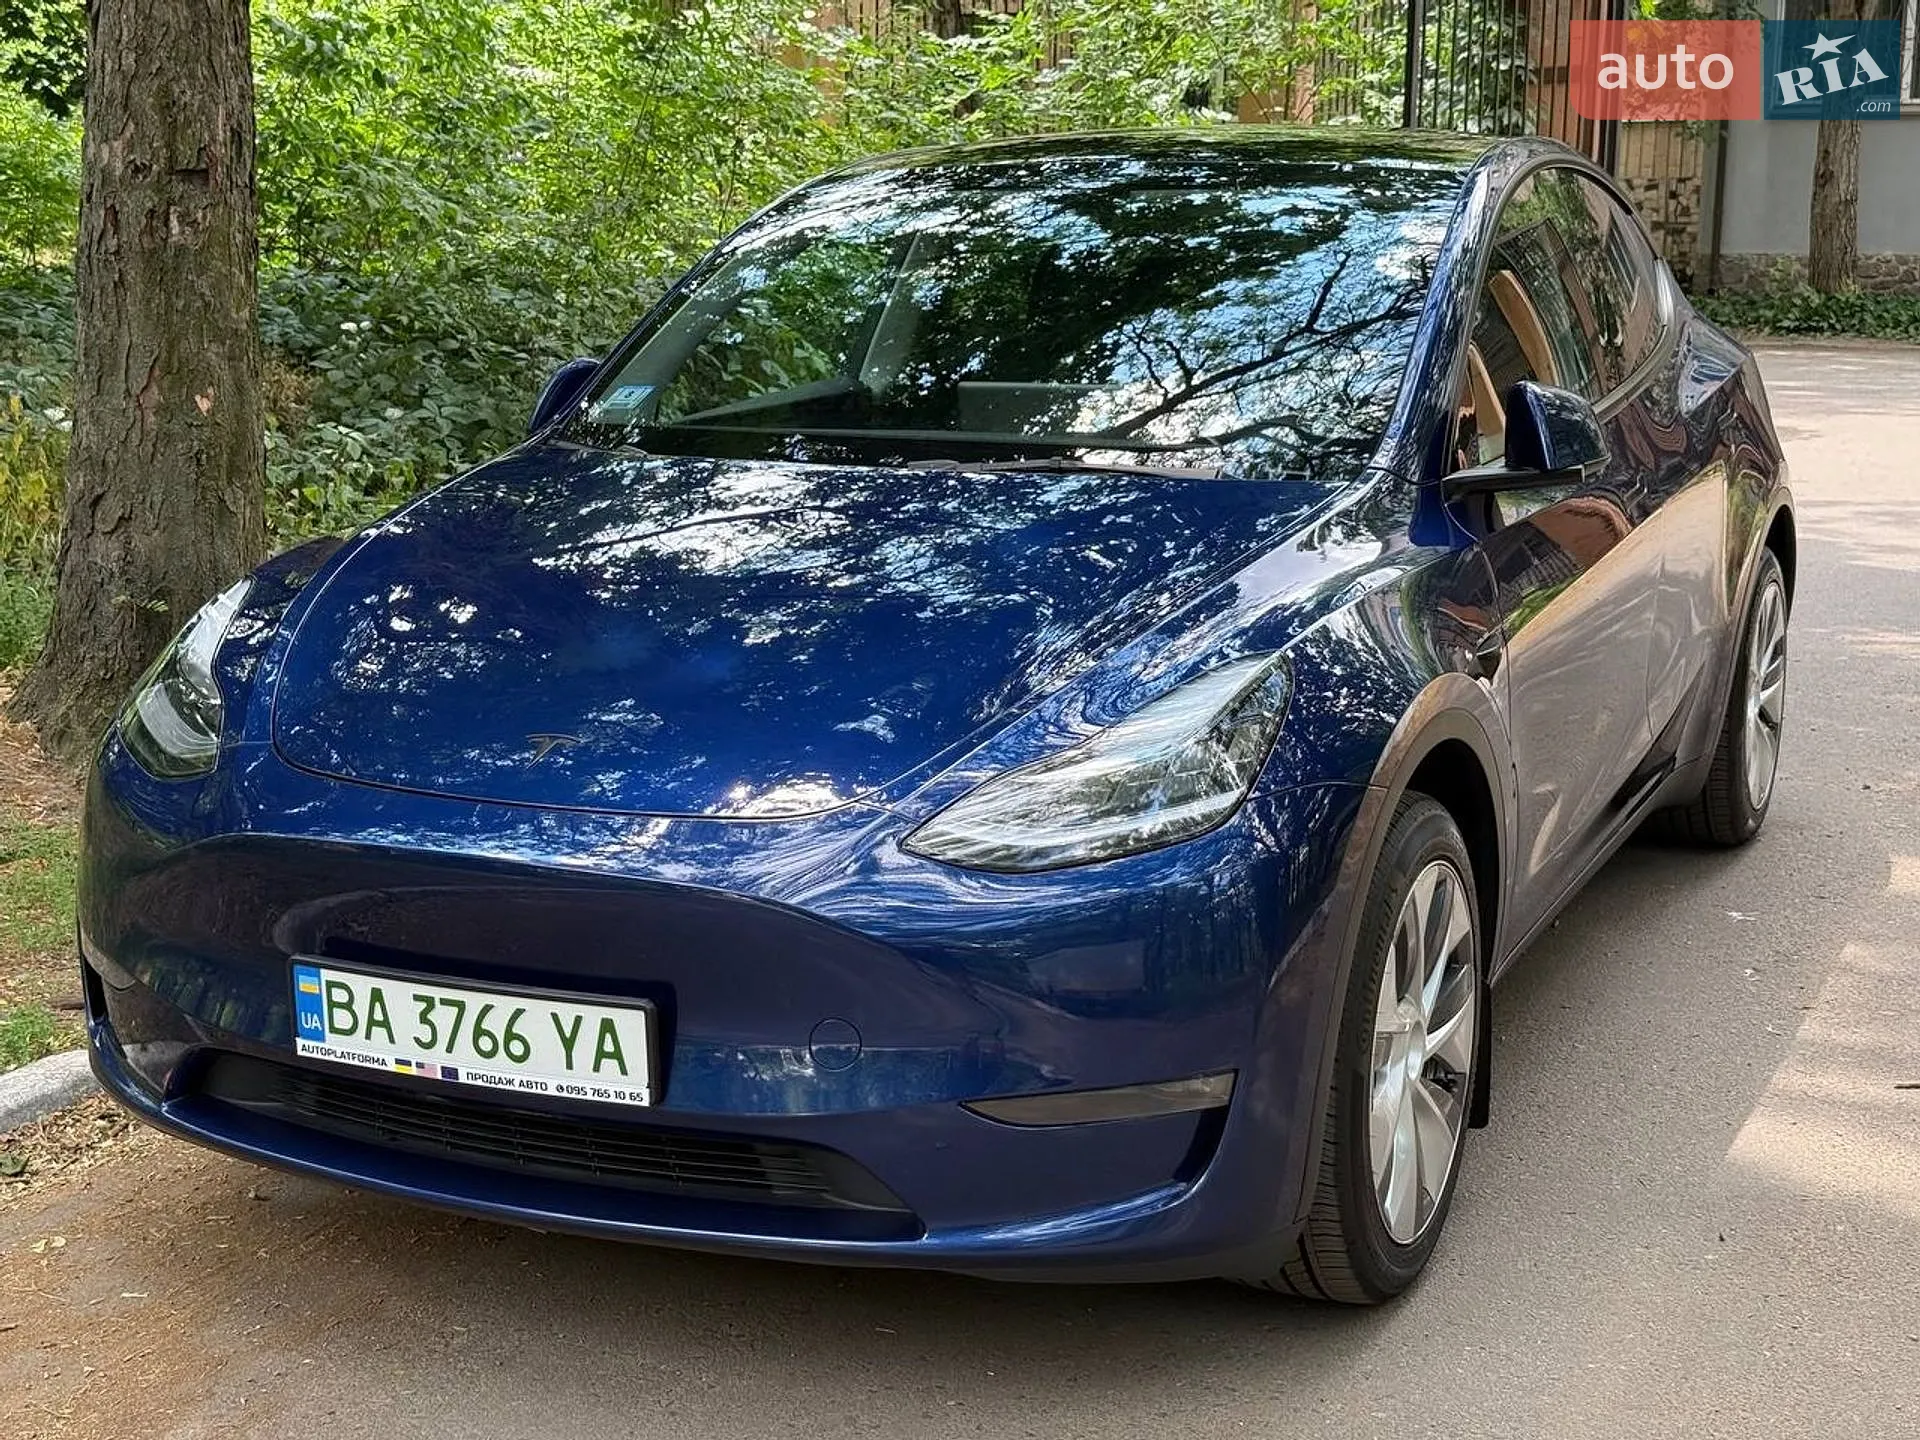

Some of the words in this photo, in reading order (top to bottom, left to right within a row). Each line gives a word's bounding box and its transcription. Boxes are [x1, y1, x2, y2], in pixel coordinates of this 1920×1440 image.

[301, 1012, 322, 1032] UA
[325, 979, 396, 1046] BA
[411, 993, 531, 1064] 3766
[550, 1012, 629, 1076] YA
[300, 1043, 389, 1068] AUTOPLATFORMA
[466, 1071, 515, 1088] ПРОДАЖ
[518, 1079, 549, 1092] АВТО
[565, 1084, 589, 1096] 095
[590, 1087, 612, 1099] 765
[614, 1090, 627, 1101] 10
[629, 1091, 644, 1103] 65
